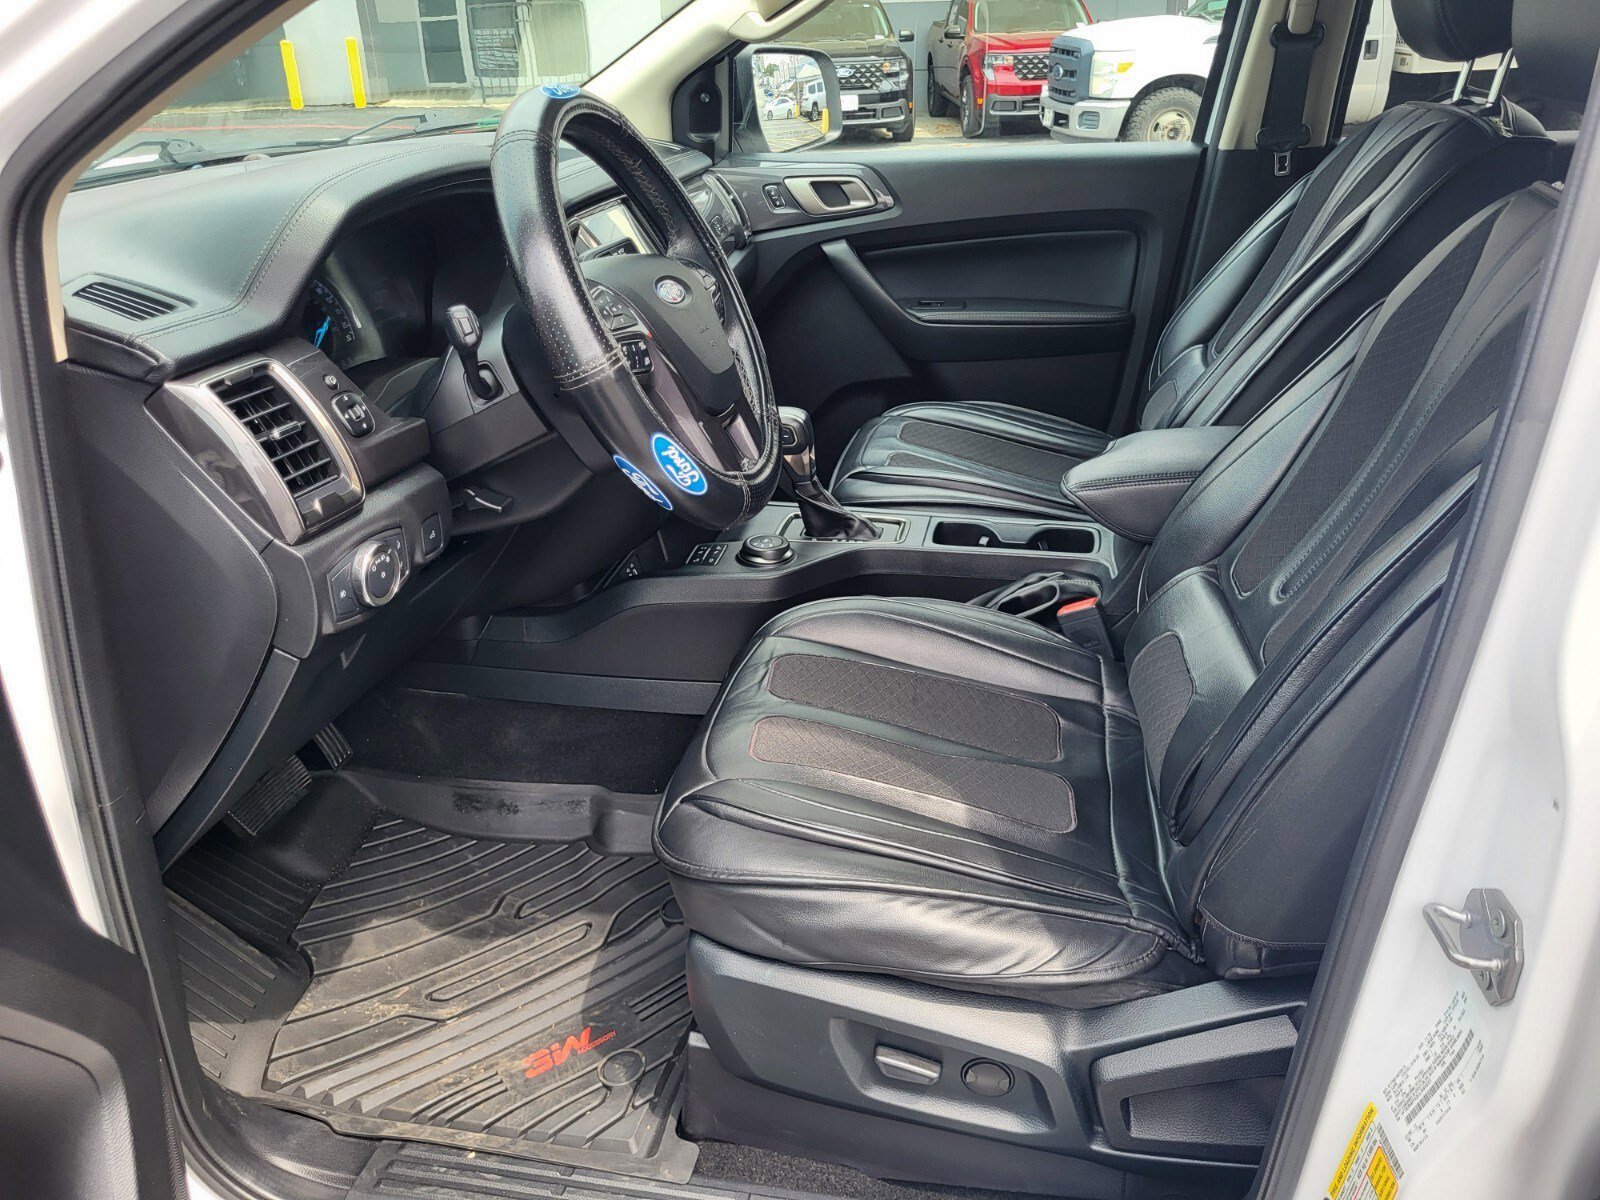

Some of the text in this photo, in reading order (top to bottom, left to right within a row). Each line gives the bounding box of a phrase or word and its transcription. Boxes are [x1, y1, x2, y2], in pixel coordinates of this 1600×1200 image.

[661, 445, 699, 486] Ford
[1342, 1147, 1355, 1171] LOADING
[1354, 1107, 1374, 1148] INFORMATION
